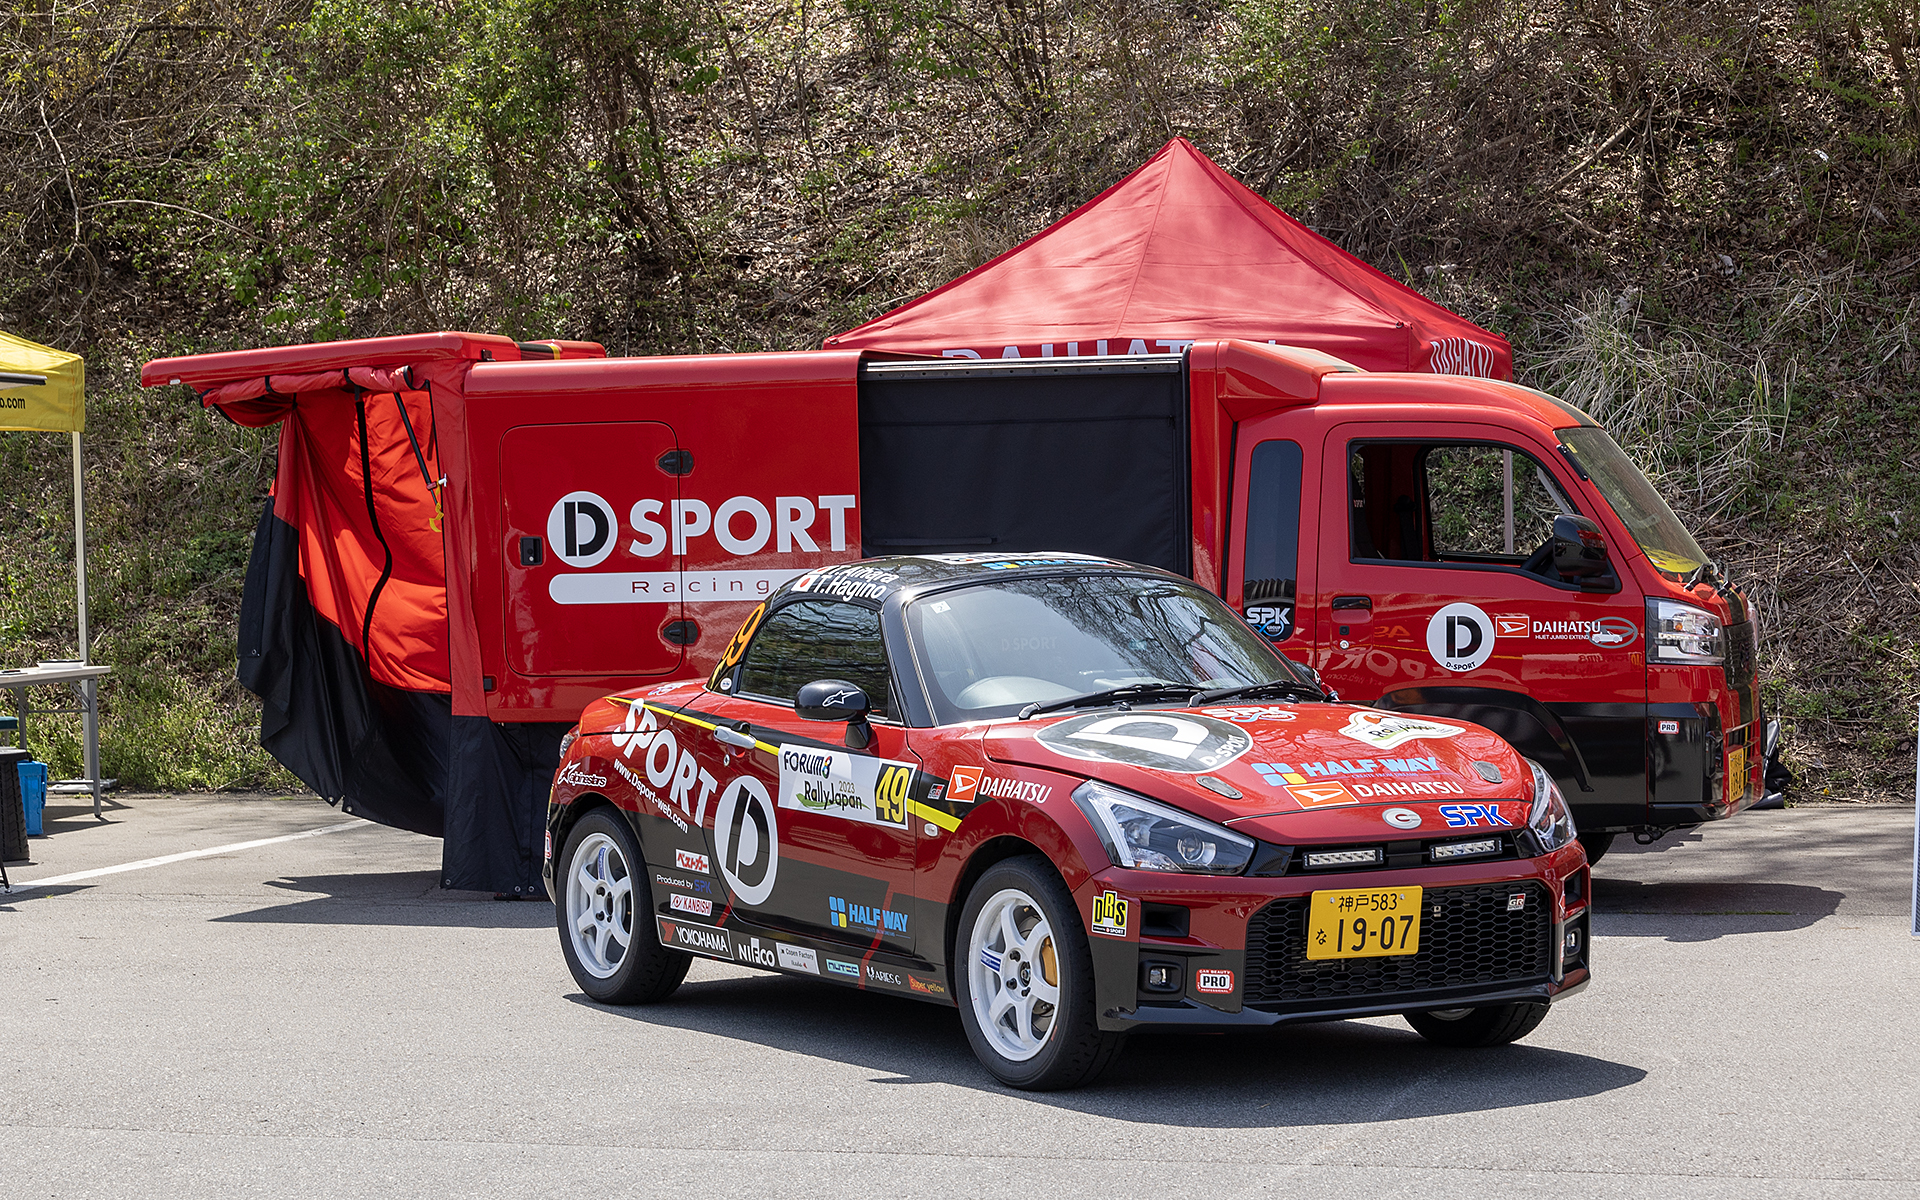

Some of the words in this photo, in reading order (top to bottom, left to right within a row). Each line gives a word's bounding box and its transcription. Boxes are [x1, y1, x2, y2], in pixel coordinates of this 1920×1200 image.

[628, 495, 857, 557] SPORT
[631, 576, 771, 595] Racing
[812, 574, 887, 602] T.Hagino
[1246, 607, 1291, 625] SPK
[1532, 620, 1601, 633] DAIHATSU
[1013, 636, 1058, 650] SPORT
[1445, 660, 1477, 671] D-SPORT
[1661, 723, 1676, 731] PRO
[611, 697, 719, 829] SPORT
[783, 750, 833, 780] FORUM8
[1300, 759, 1379, 778] HALF
[1378, 756, 1440, 773] WAY
[613, 758, 689, 834] www.Dsport-web.com
[804, 780, 863, 811] RallyJapan
[838, 780, 855, 794] 2023
[875, 765, 909, 823] 49
[978, 776, 1052, 804] DAIHATSU
[1351, 781, 1465, 797] DAIHATSU
[1438, 804, 1513, 828] SPK
[677, 852, 708, 871] ベストカー
[656, 874, 685, 887] Produced
[685, 880, 693, 890] by
[693, 879, 712, 894] SPK
[682, 897, 712, 915] KANBISHI
[1094, 892, 1127, 927] DRS
[1508, 898, 1524, 906] GR
[848, 903, 881, 926] HALF
[882, 909, 908, 933] WAY
[675, 926, 729, 953] YOKOHAMA
[1315, 928, 1327, 945] な
[1336, 914, 1414, 953] 19-07
[737, 937, 776, 967] NIFCO
[1202, 975, 1227, 987] PRO
